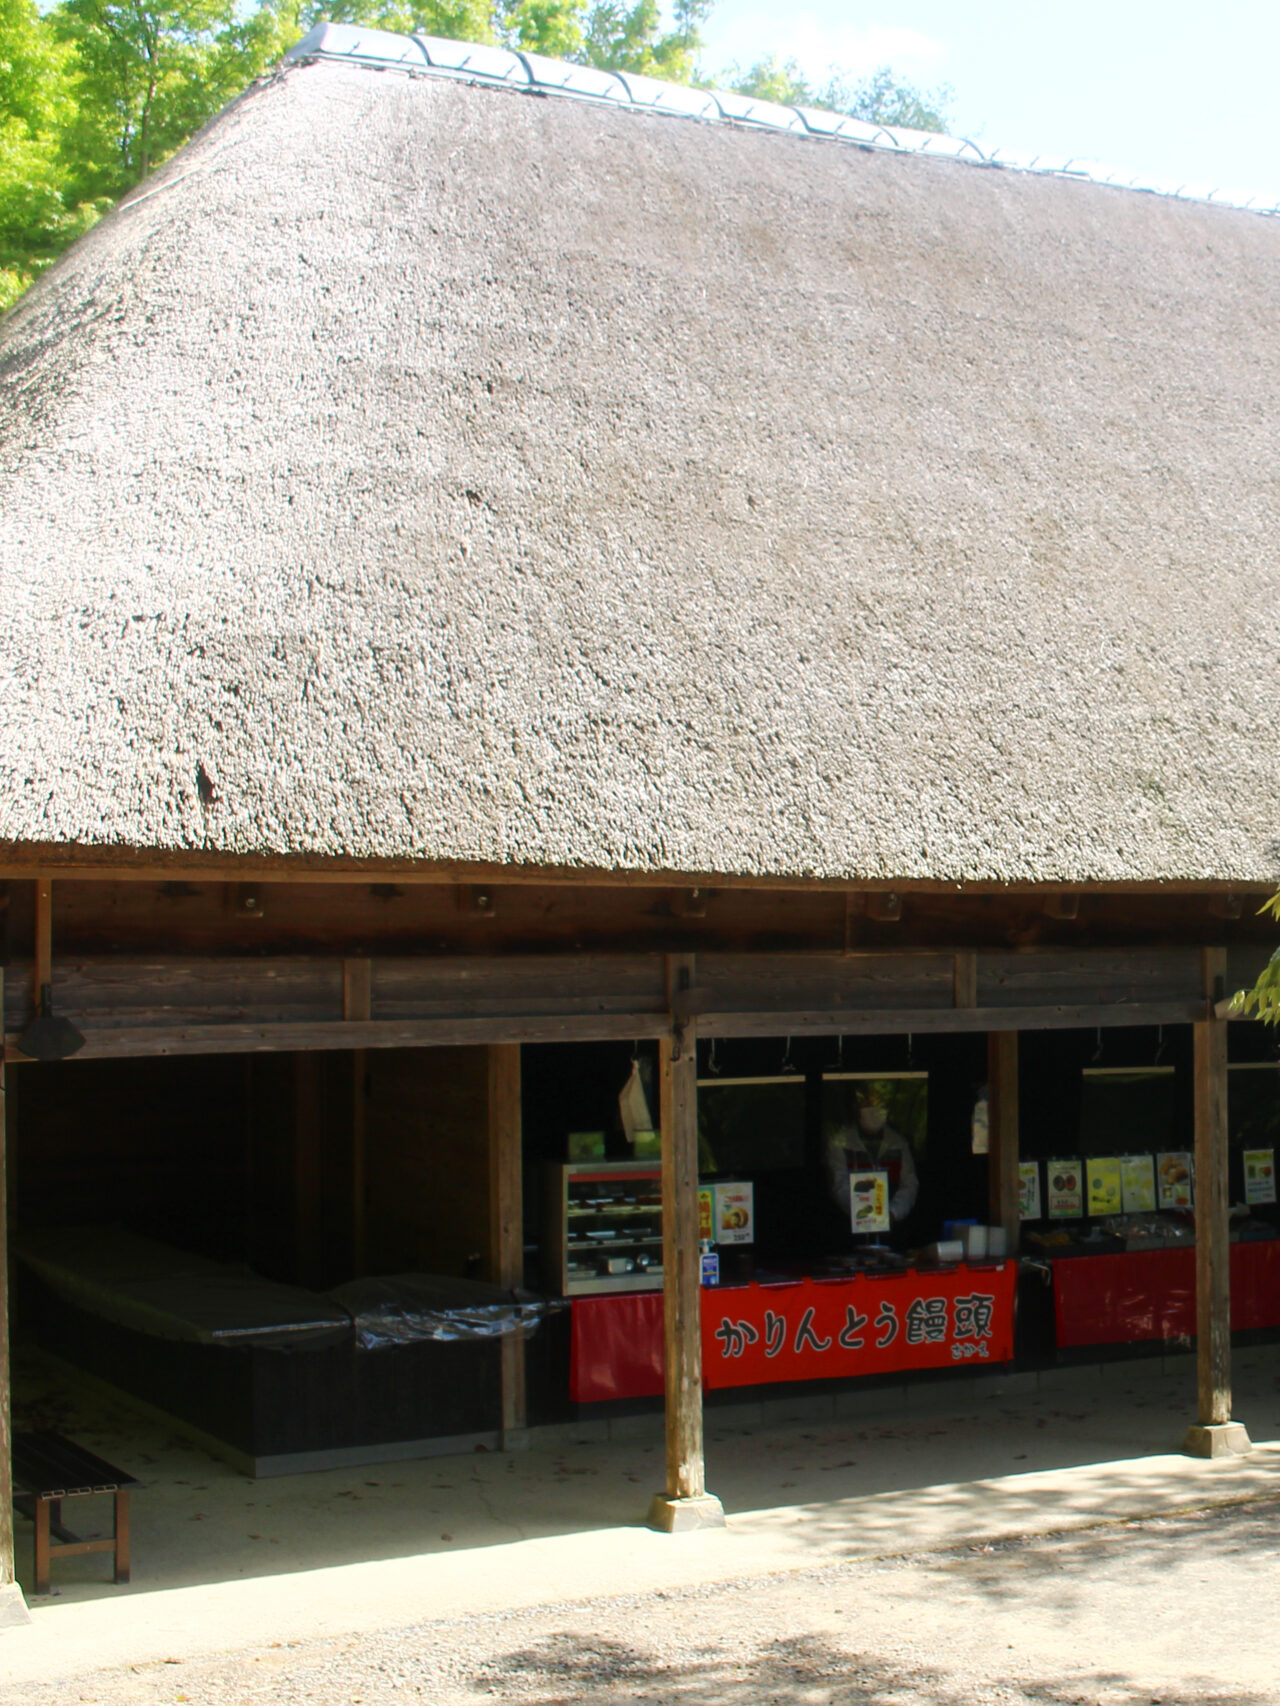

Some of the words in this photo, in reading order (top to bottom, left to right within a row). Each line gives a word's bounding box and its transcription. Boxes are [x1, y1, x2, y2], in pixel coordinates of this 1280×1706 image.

[716, 1292, 995, 1357] かりんとう饅頭
[950, 1340, 990, 1359] さかえ
